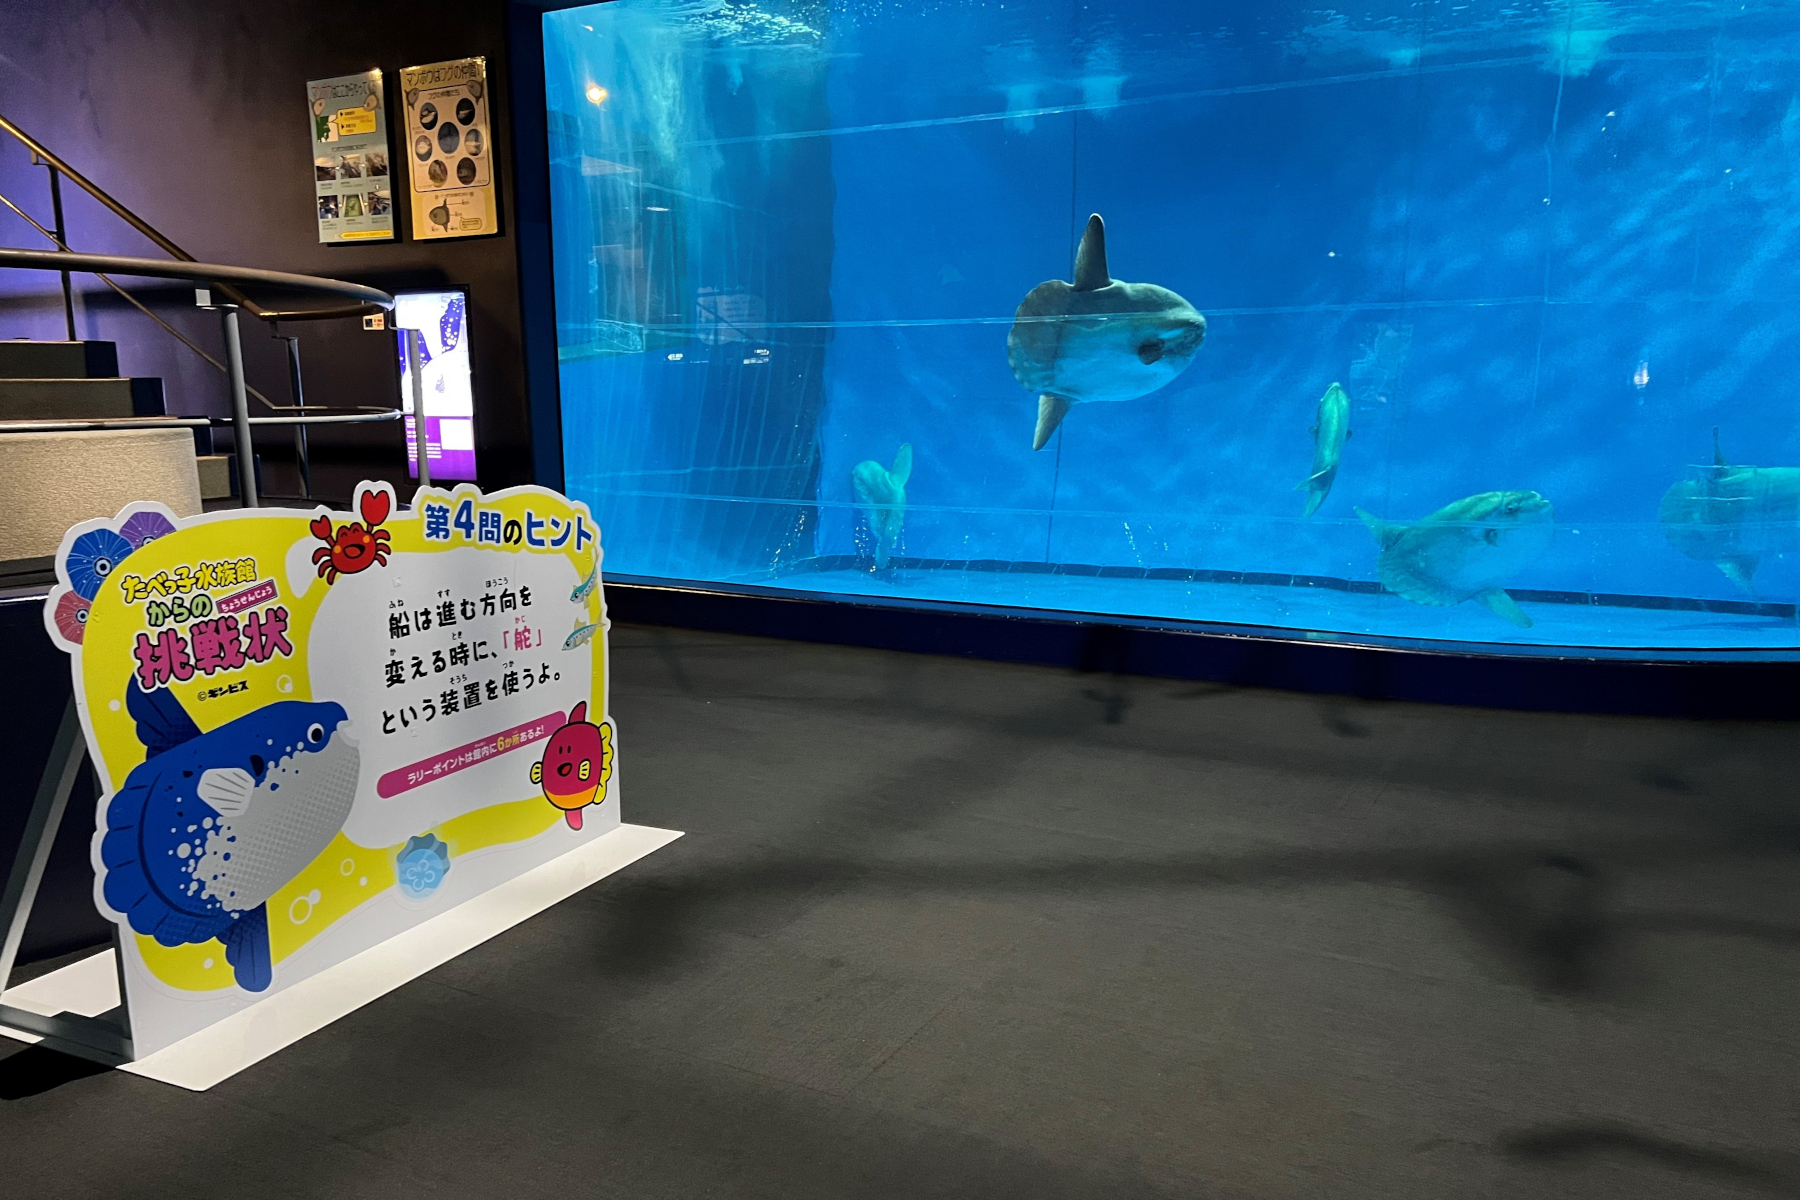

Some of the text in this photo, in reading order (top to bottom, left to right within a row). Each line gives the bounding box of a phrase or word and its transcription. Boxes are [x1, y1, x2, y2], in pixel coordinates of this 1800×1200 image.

[424, 500, 592, 551] 第4問のヒント
[121, 558, 257, 604] たべっ子水族館
[437, 589, 450, 598] すす
[485, 577, 509, 588] ほうこう
[147, 594, 213, 627] からの
[221, 586, 273, 612] ちょうせんじょう
[388, 599, 405, 609] ふね
[388, 585, 532, 639] 船は進む方向を
[514, 615, 526, 625] かじ
[134, 606, 293, 690] 挑戦状
[452, 631, 463, 641] とき
[384, 625, 543, 688] 変える時に、「舵」
[389, 648, 397, 657] か
[502, 660, 515, 669] つか
[450, 674, 468, 684] そうち
[382, 662, 560, 735] という装置を使うよ。
[407, 725, 545, 785] ラリーポイントは館内に6か所あるよ!
